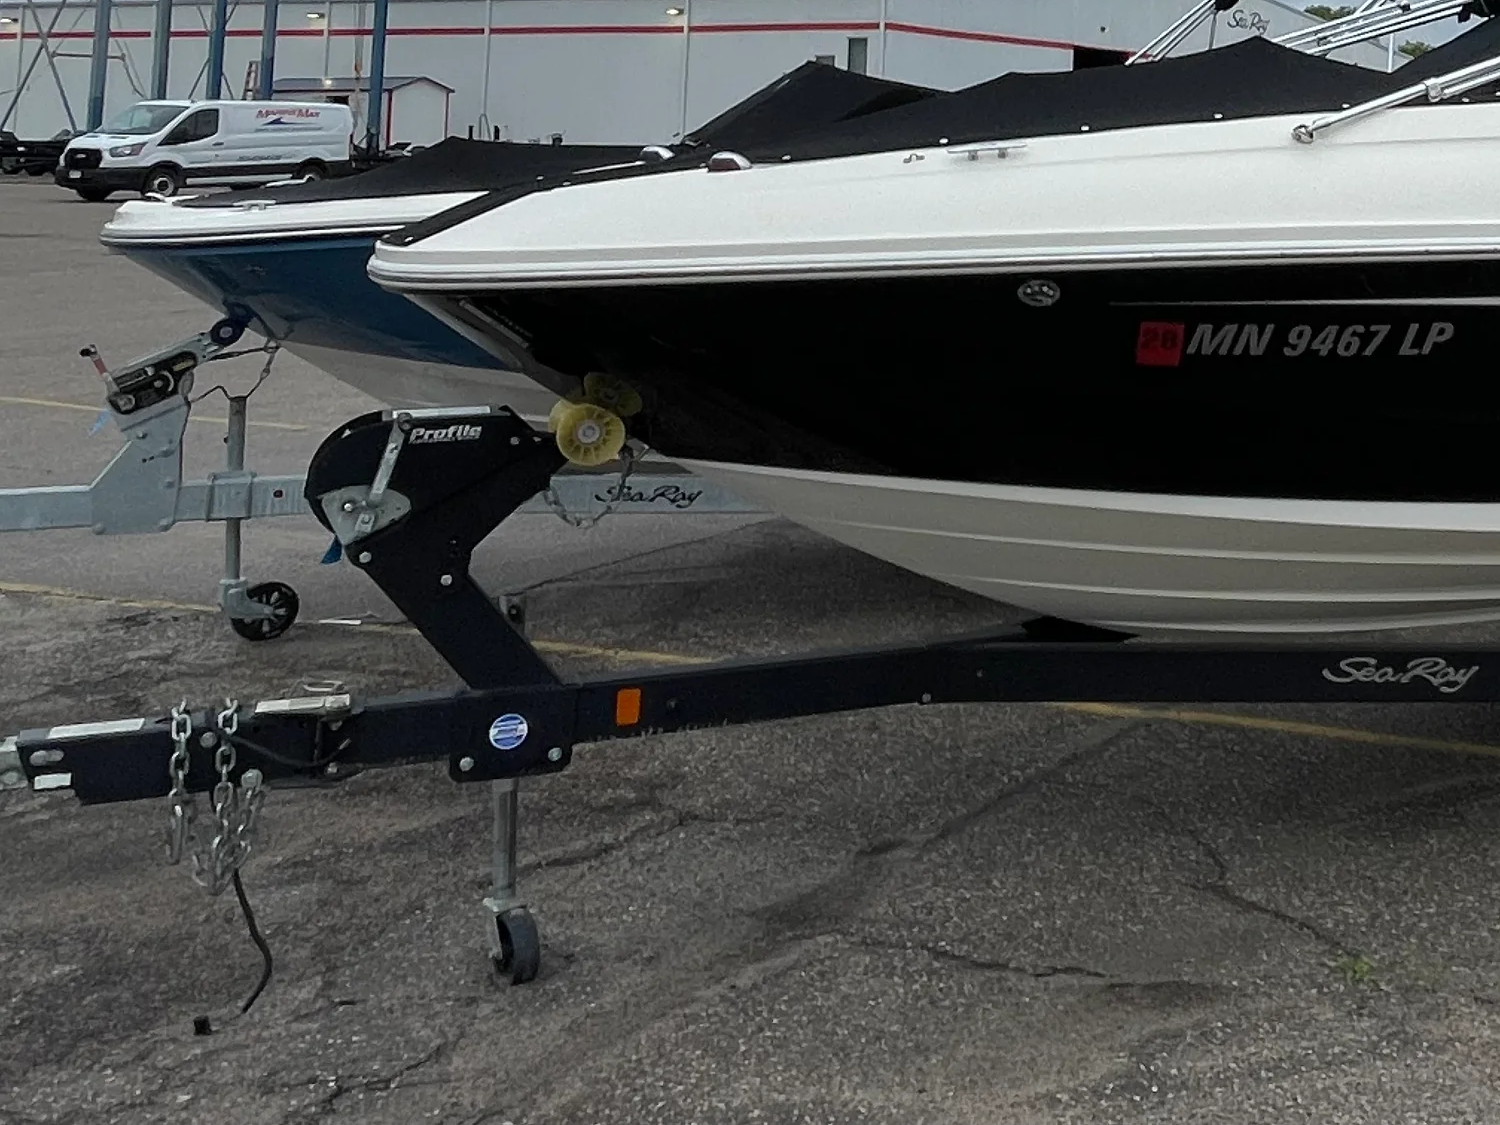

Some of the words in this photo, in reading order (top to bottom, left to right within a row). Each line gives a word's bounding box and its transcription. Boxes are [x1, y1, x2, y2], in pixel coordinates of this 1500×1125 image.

[1186, 324, 1274, 355] MN
[1283, 324, 1391, 357] 9467
[1398, 322, 1454, 355] LP
[409, 425, 482, 444] Profile
